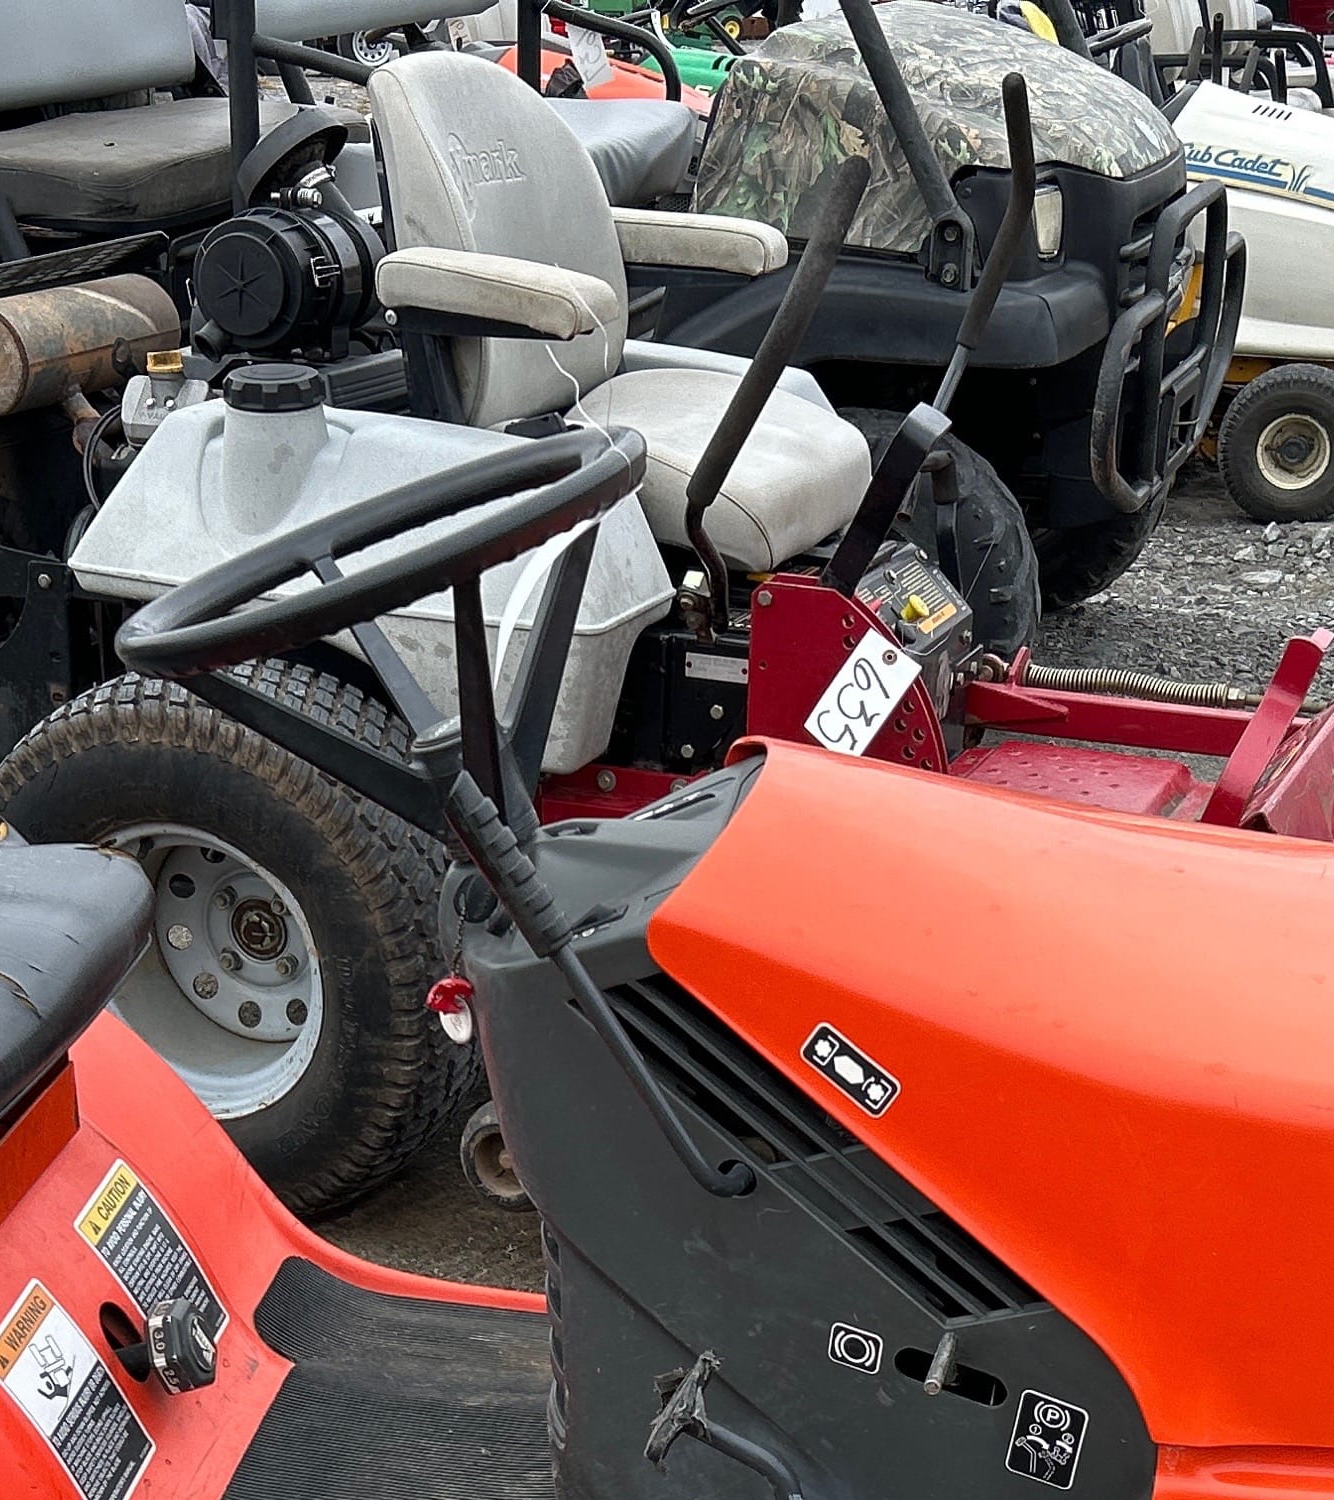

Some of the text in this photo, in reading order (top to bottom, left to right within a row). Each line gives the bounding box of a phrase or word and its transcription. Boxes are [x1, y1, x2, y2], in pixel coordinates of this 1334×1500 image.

[1213, 149, 1290, 178] Cadet
[817, 657, 890, 751] 635
[97, 1174, 131, 1221] CAUTION
[3, 1295, 47, 1352] WARNING
[153, 1327, 165, 1352] 3.0
